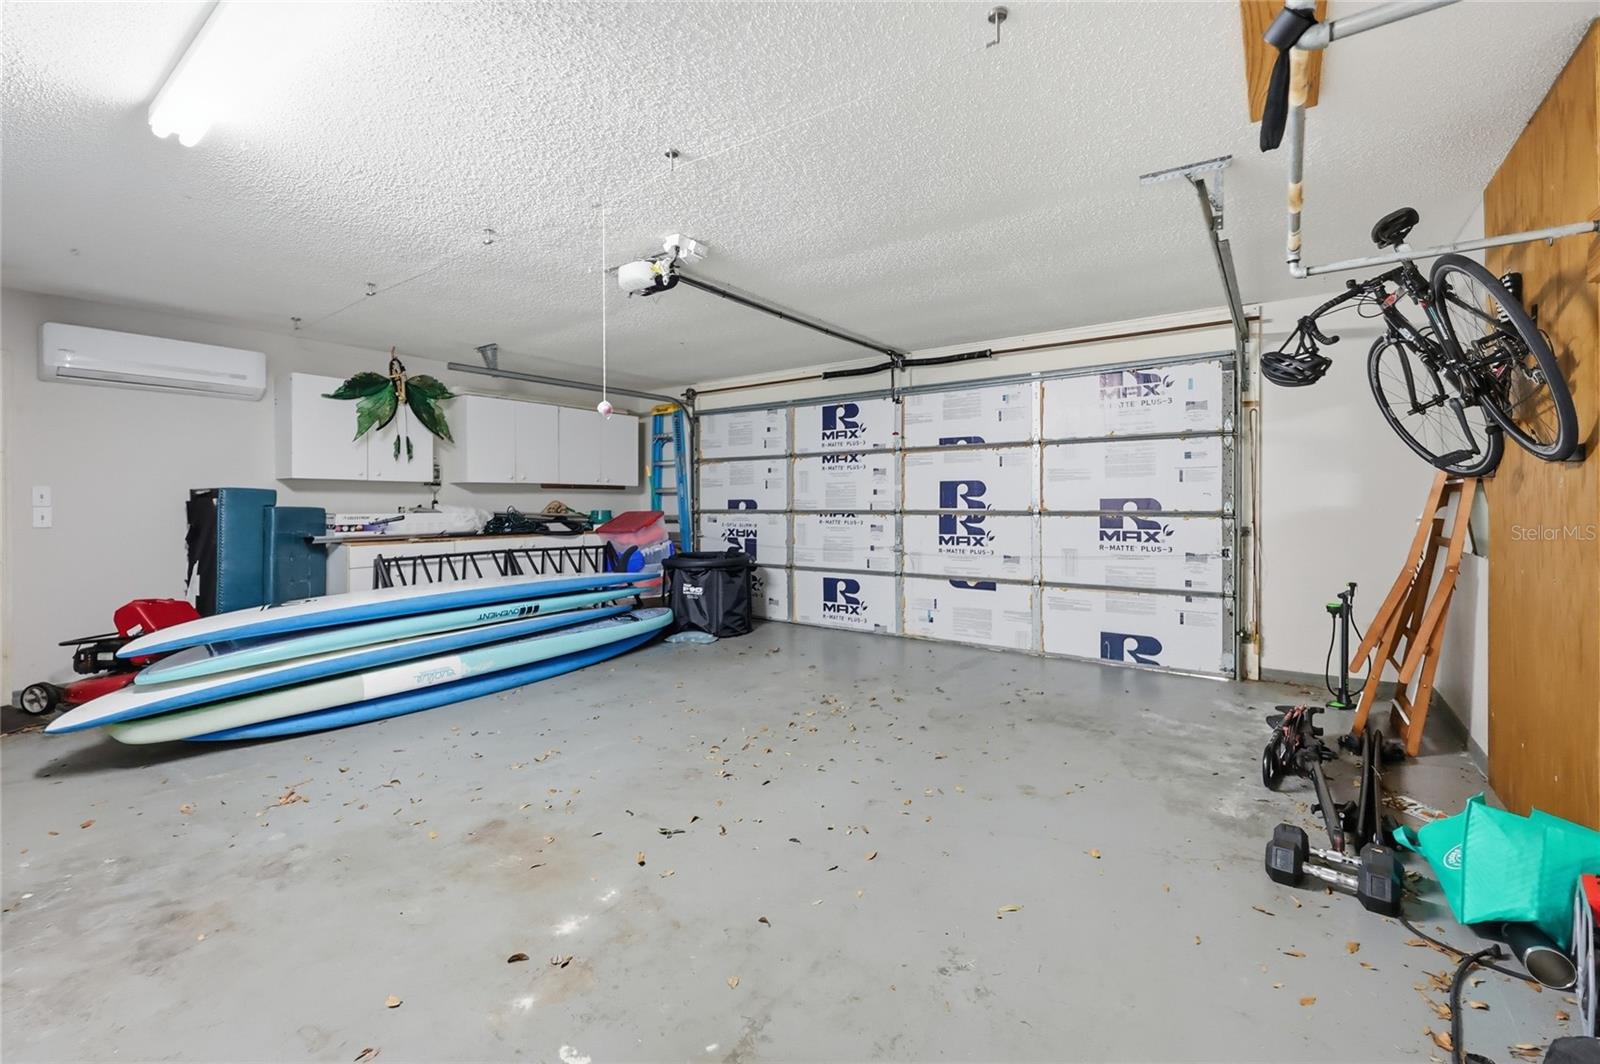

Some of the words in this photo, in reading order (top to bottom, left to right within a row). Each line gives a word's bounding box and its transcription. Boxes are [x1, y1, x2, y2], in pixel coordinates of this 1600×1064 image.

[1100, 384, 1160, 399] MAX
[1140, 397, 1173, 406] PLUS-3
[822, 403, 860, 430] R
[822, 430, 859, 440] MAX
[822, 454, 859, 464] MAX
[939, 480, 987, 509] R
[727, 528, 757, 538] MAX
[1100, 530, 1161, 543] MAX
[939, 536, 985, 546] MAX
[1099, 544, 1135, 552] R-MATTE
[1140, 545, 1173, 553] PLUS-3
[823, 577, 861, 605] R
[823, 603, 859, 615] MAX
